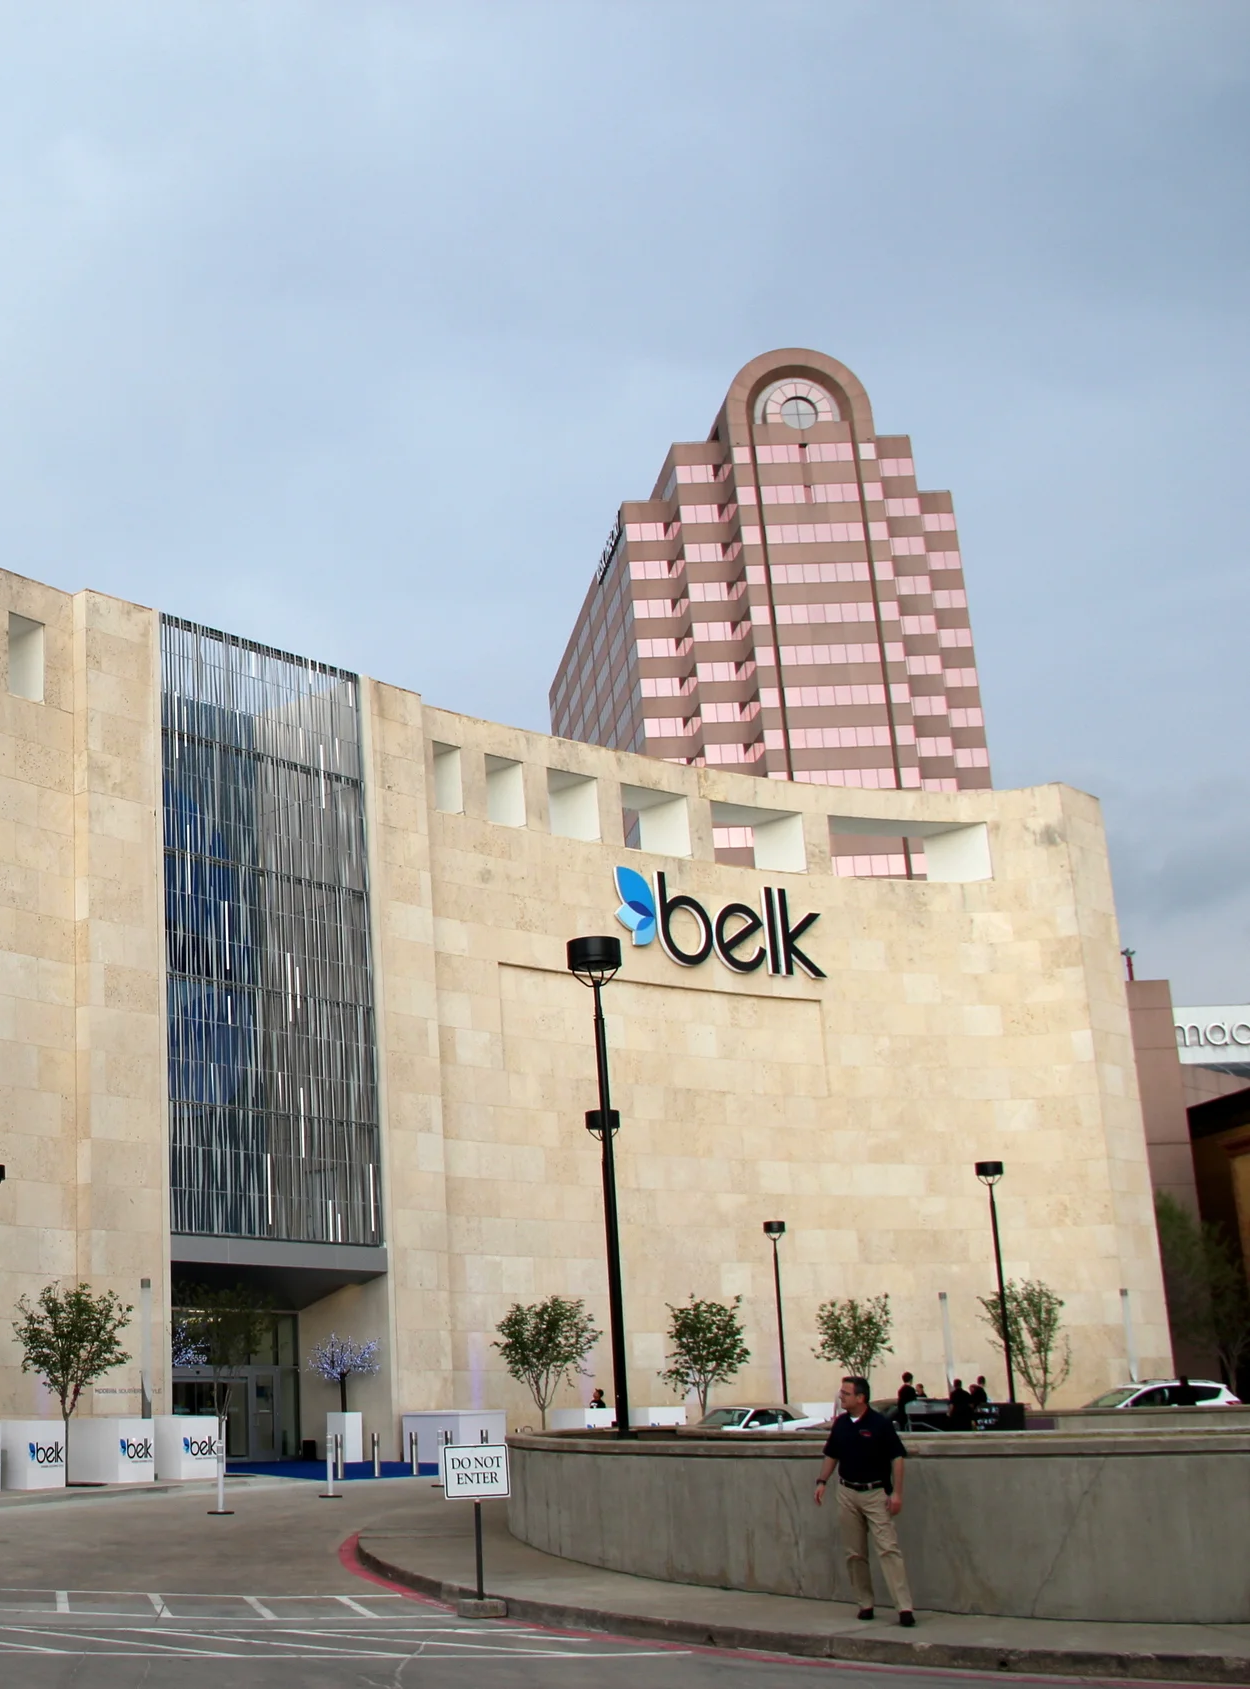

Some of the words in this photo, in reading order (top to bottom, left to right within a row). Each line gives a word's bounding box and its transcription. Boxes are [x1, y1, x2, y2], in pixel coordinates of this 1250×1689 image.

[653, 870, 828, 980] belk
[36, 1441, 63, 1463] belk
[127, 1438, 153, 1459] belk
[190, 1436, 217, 1456] belk
[451, 1457, 471, 1469] DO
[474, 1456, 502, 1468] NOT
[456, 1472, 499, 1484] ENTER
